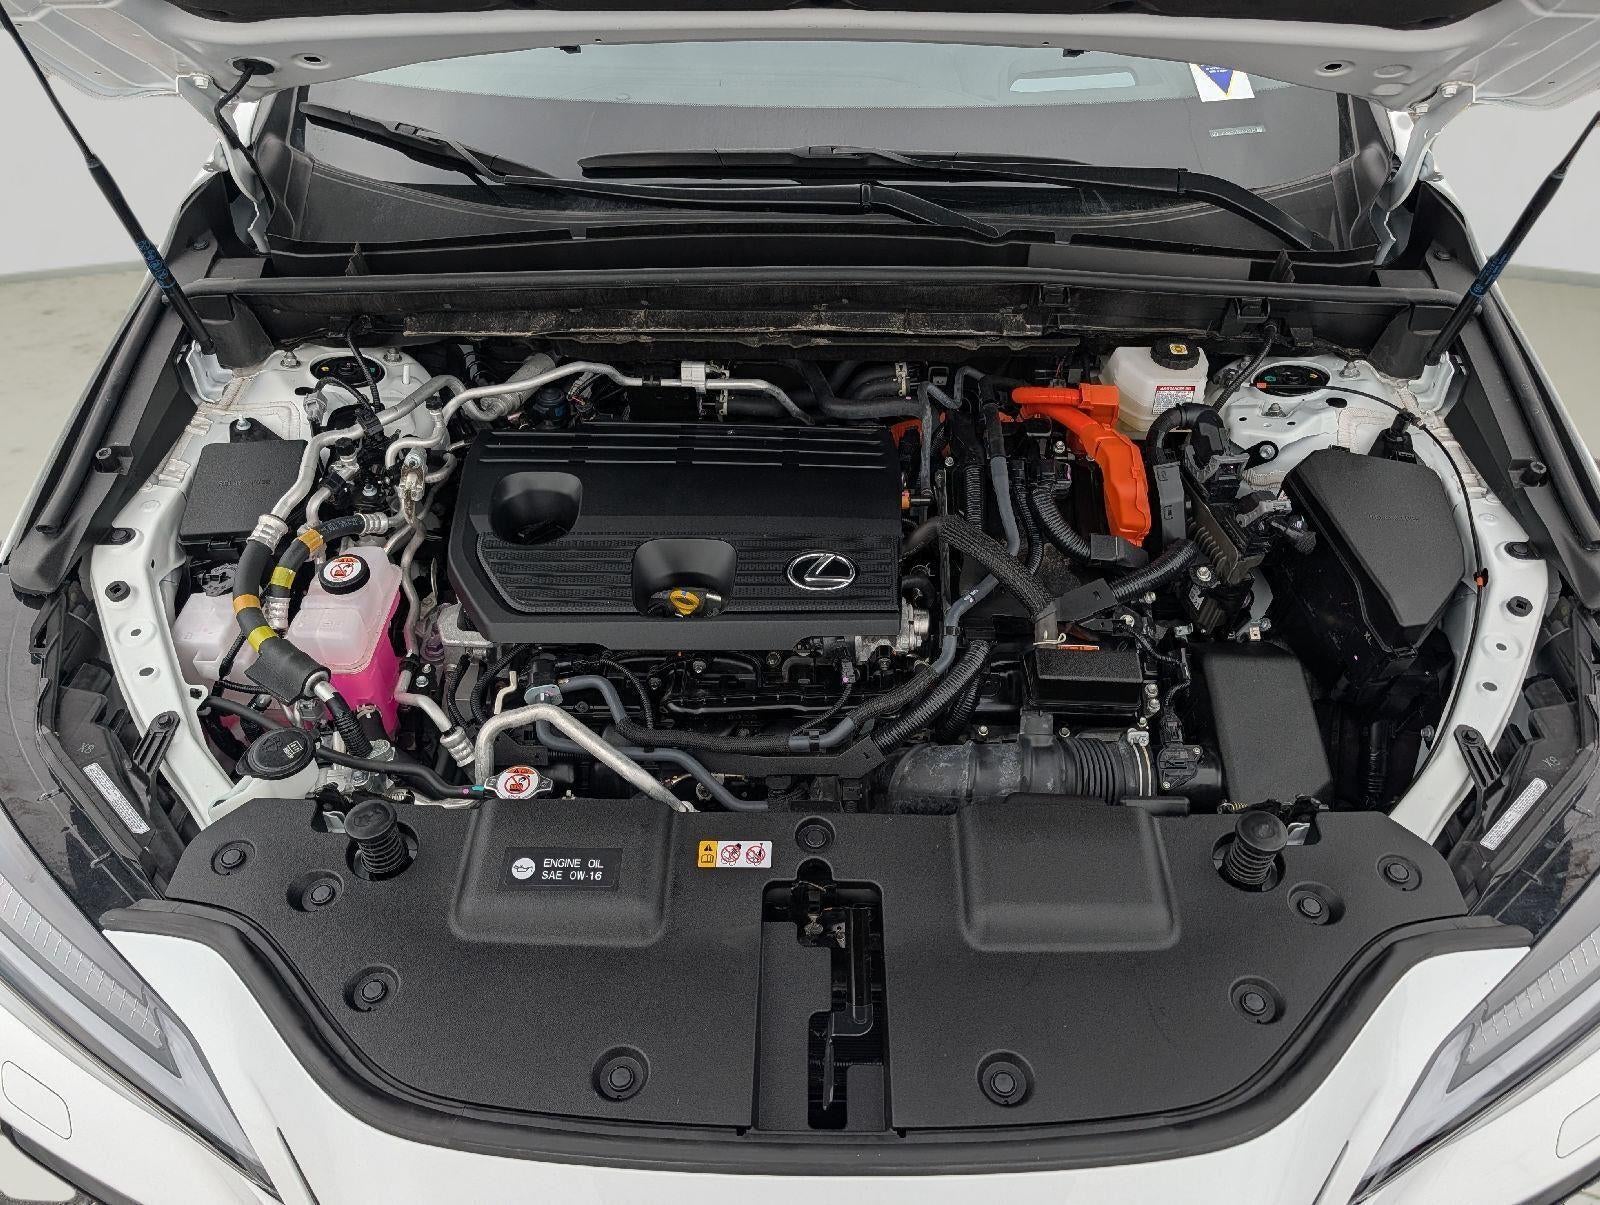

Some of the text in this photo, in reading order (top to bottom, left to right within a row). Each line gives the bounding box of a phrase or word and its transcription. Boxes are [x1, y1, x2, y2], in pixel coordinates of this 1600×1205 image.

[543, 858, 604, 868] ENGINE OIL
[541, 870, 603, 881] SAE 0W-16
